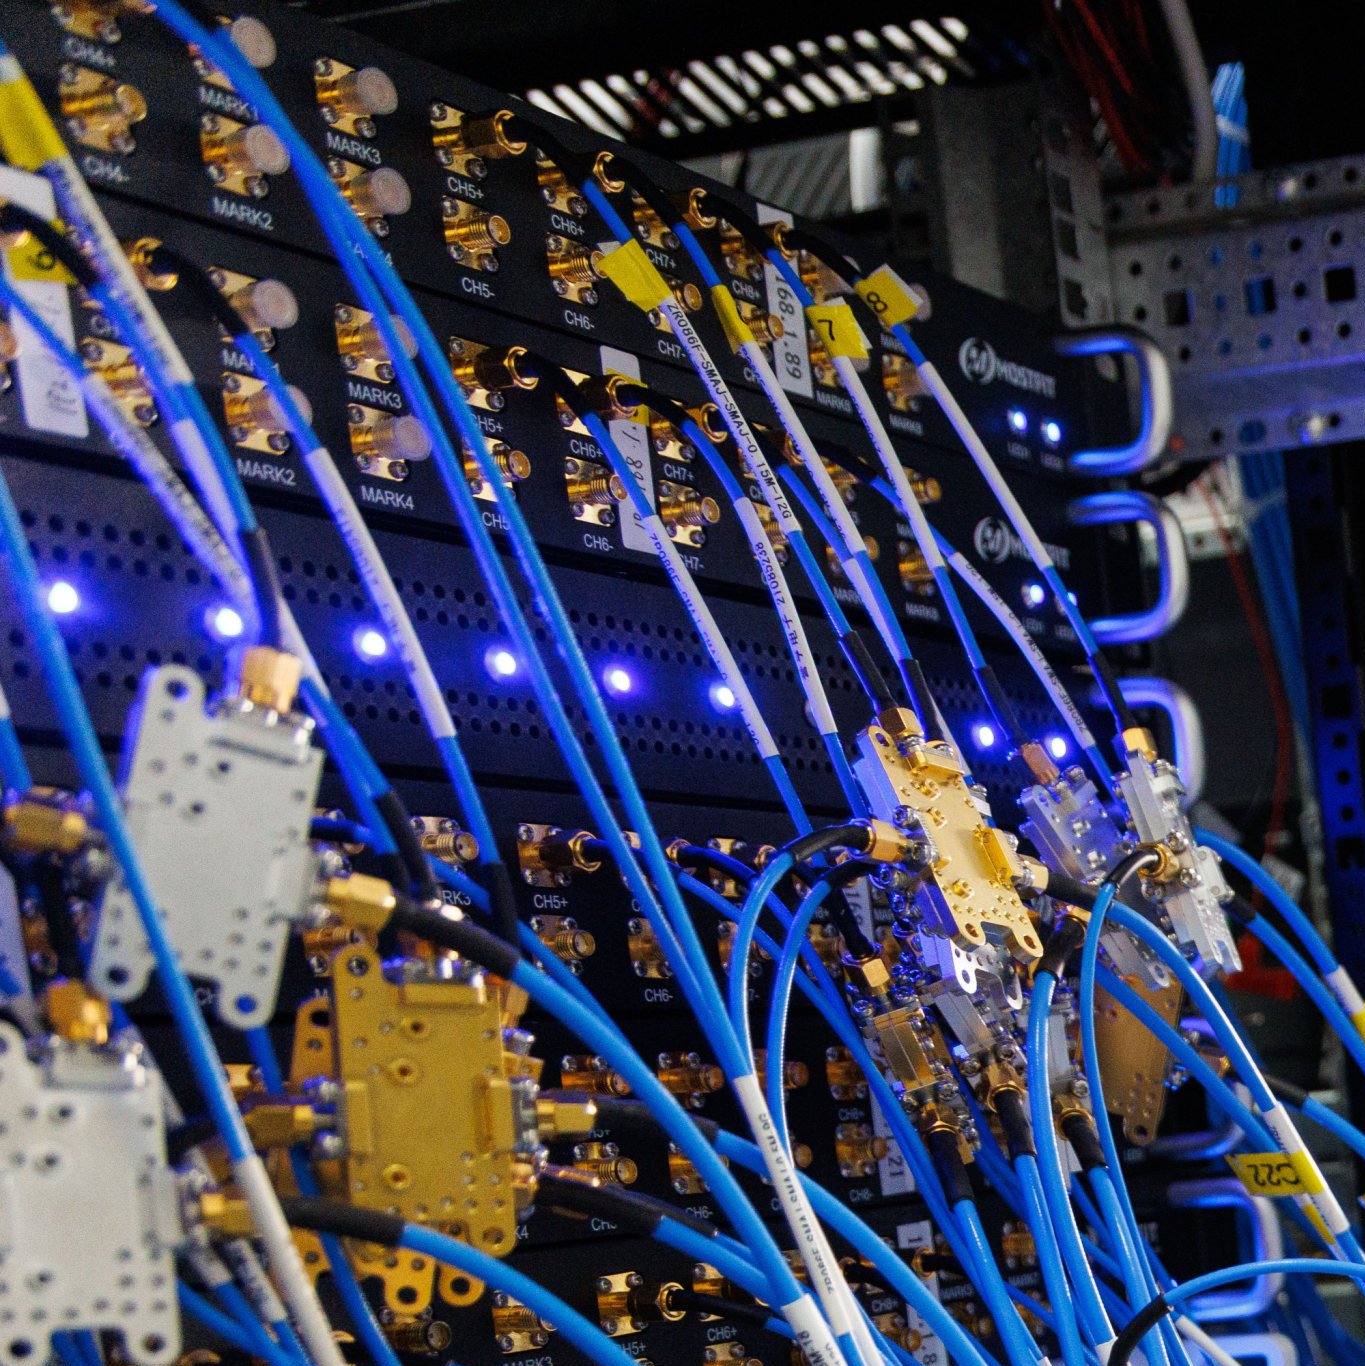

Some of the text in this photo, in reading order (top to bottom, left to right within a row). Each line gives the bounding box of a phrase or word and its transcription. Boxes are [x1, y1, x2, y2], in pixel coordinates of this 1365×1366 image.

[325, 131, 383, 164] MARK3
[446, 176, 485, 200] CH5+
[213, 198, 275, 231] MARK2
[551, 213, 586, 237] CH6+
[646, 248, 677, 270] CH7+
[460, 276, 496, 300] CH5-
[732, 279, 761, 300] CH8+
[563, 309, 595, 331] CH6-
[657, 338, 687, 360] CH7-
[348, 382, 402, 409] MARK3
[237, 458, 297, 487] MARK2
[663, 463, 695, 482] CH7+
[361, 485, 415, 512] MARK4
[584, 533, 615, 552] CH6-
[533, 893, 568, 910] CH5+
[644, 987, 674, 1002] CH6-
[838, 1107, 866, 1122] CH8+
[1246, 1161, 1301, 1187] C22
[707, 1326, 738, 1342] CH6+
